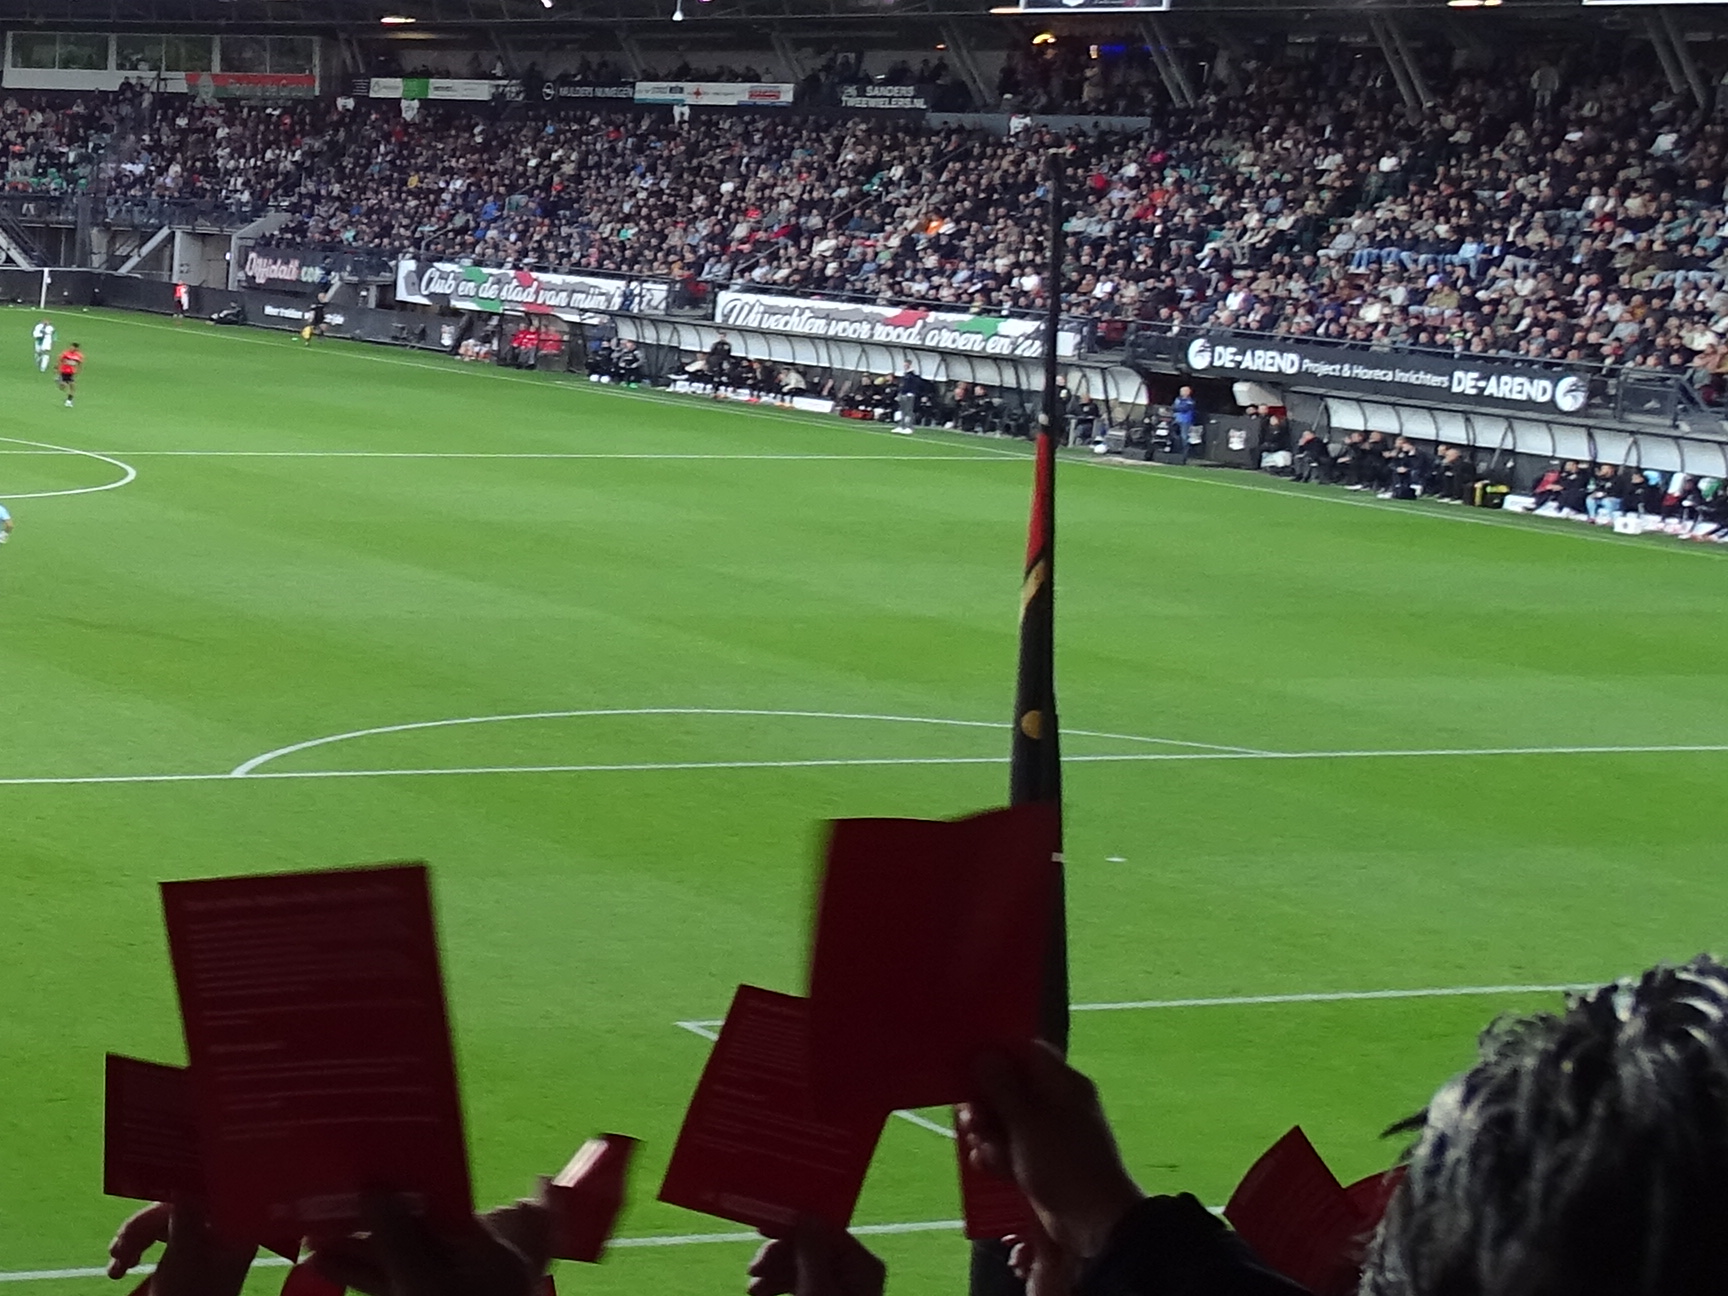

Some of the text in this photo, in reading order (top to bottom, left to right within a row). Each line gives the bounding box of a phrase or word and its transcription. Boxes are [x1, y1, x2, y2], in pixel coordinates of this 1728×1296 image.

[865, 85, 915, 97] SANDERS
[421, 267, 455, 294] Club
[457, 280, 476, 296] en
[478, 275, 498, 299] de
[499, 278, 535, 306] stad
[537, 288, 569, 308] van
[761, 306, 826, 336] vechten
[827, 317, 872, 339] voor
[986, 336, 1013, 356] en
[1212, 347, 1553, 403] DE-AREND Project & Horeca Inrichters DE-AREND
